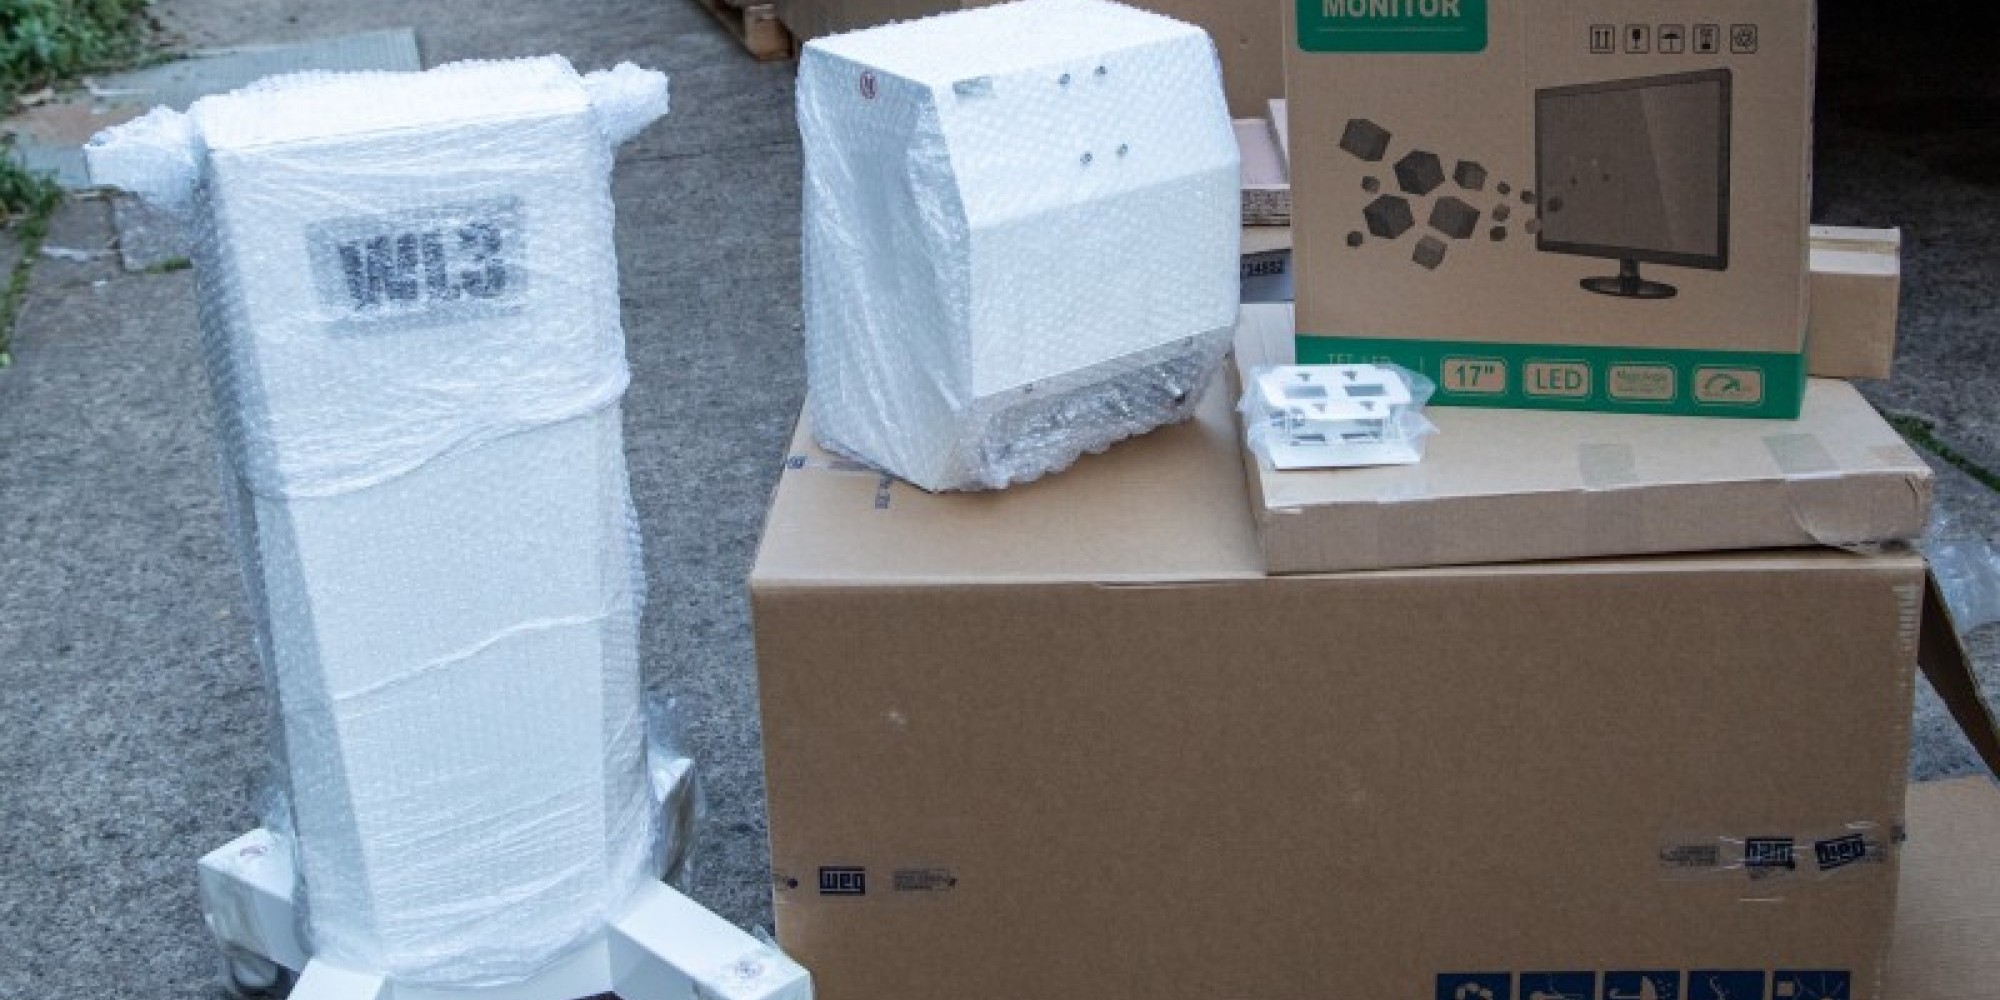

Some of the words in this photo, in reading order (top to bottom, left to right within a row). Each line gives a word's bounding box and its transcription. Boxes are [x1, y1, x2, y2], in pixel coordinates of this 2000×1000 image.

[1322, 0, 1461, 18] MONITOR
[1455, 365, 1496, 388] 17"
[1536, 368, 1582, 390] LED
